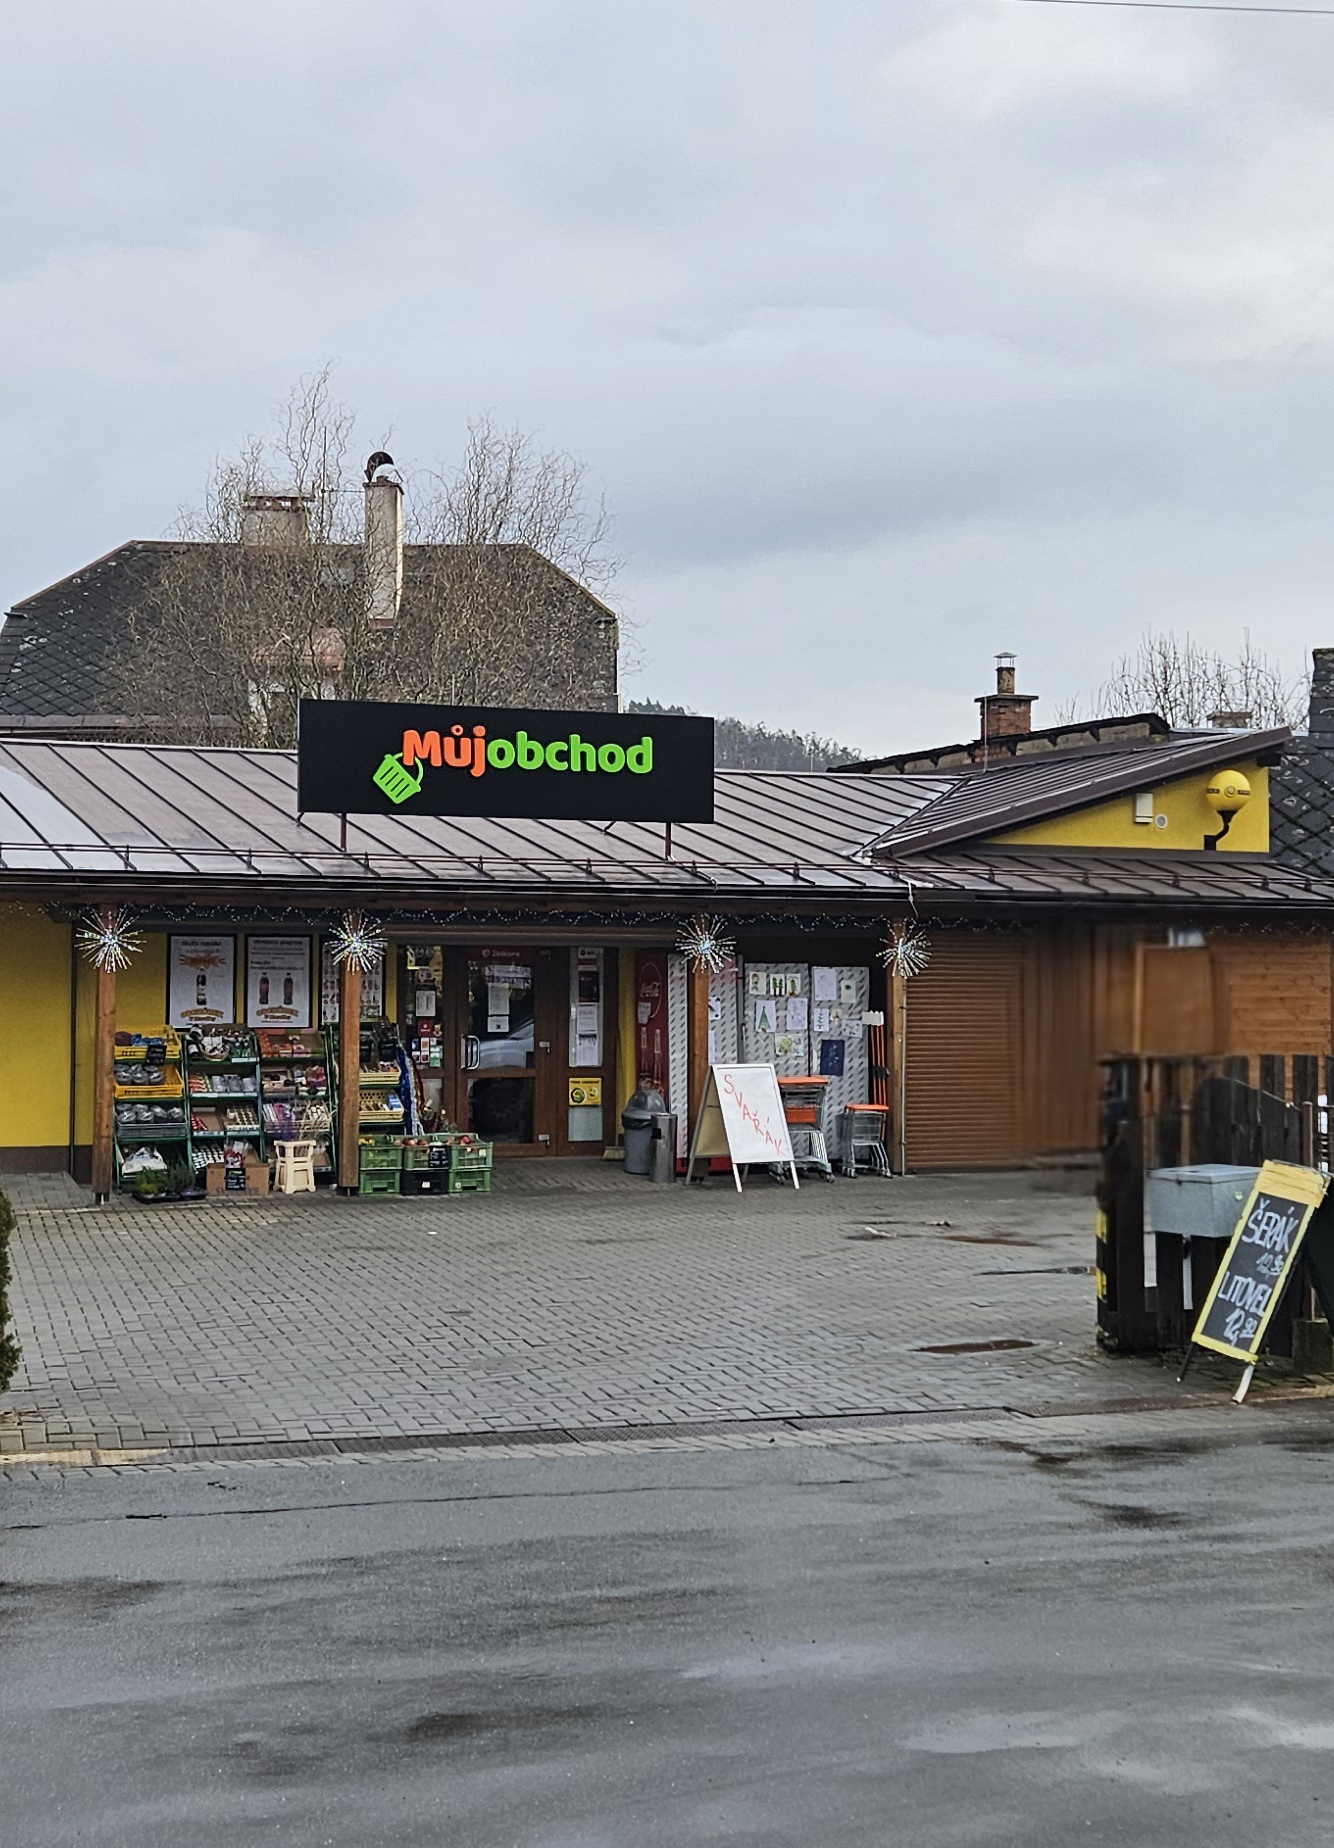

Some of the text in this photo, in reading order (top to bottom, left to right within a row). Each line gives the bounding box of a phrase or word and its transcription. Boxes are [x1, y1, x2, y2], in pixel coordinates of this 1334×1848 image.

[403, 725, 653, 777] Můjobchod
[723, 1074, 786, 1156] SVAŘÁK
[1241, 1199, 1299, 1254] ŠERÁK
[1217, 1271, 1273, 1318] LITOVEL
